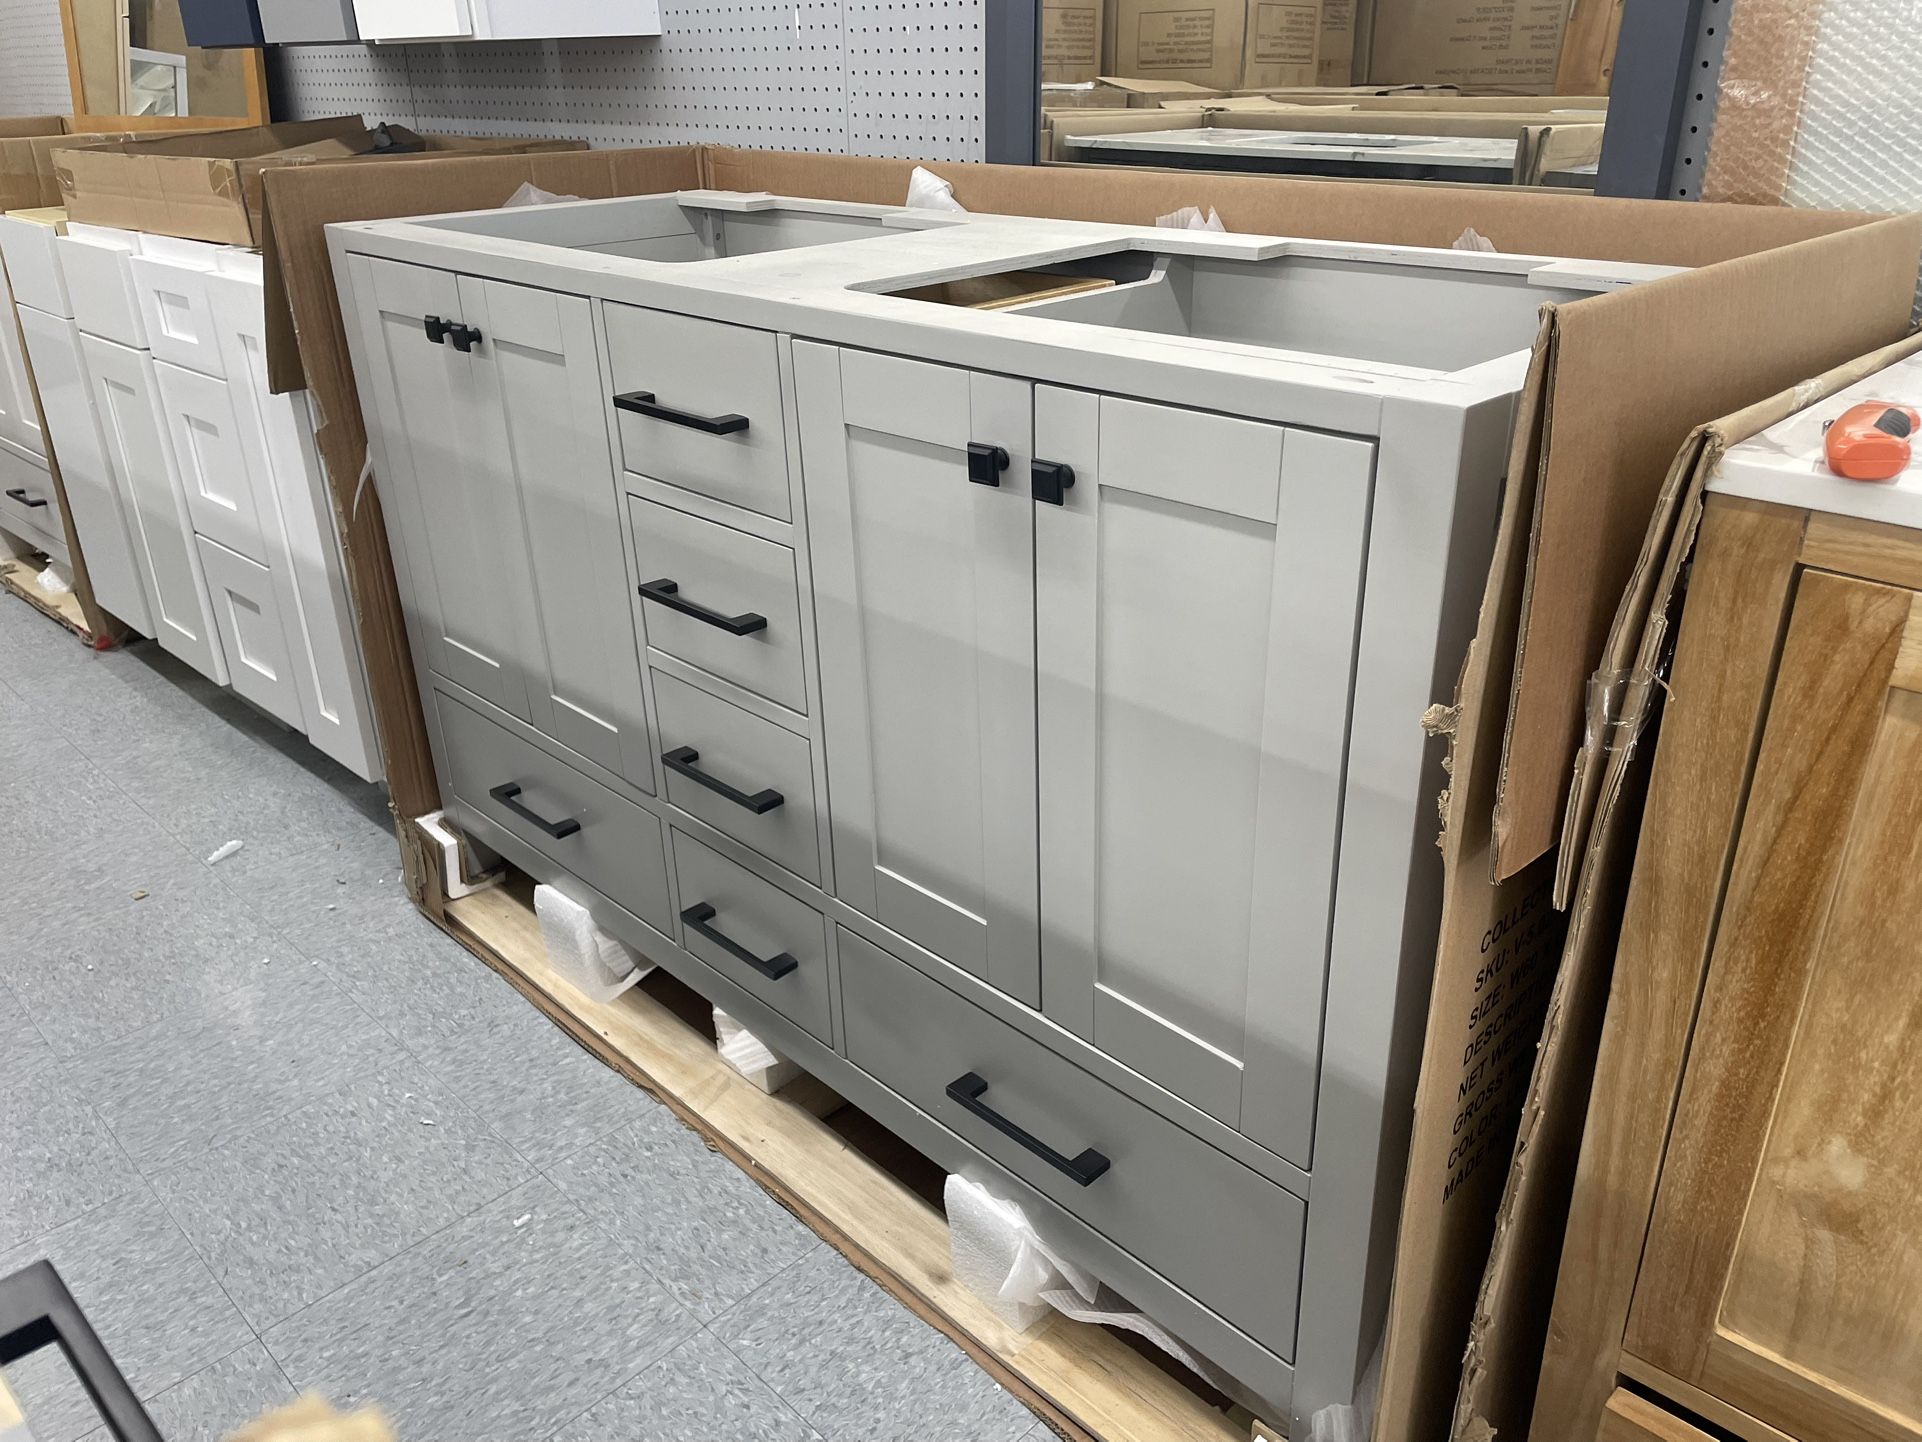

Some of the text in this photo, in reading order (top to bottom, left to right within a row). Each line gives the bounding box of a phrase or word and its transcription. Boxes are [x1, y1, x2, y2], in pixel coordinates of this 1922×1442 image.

[1474, 948, 1510, 992] SKU:
[1469, 983, 1506, 1029] SIZE:
[1453, 1070, 1503, 1135] GROSS
[1458, 1056, 1489, 1103] NET
[1443, 1143, 1486, 1204] MADE
